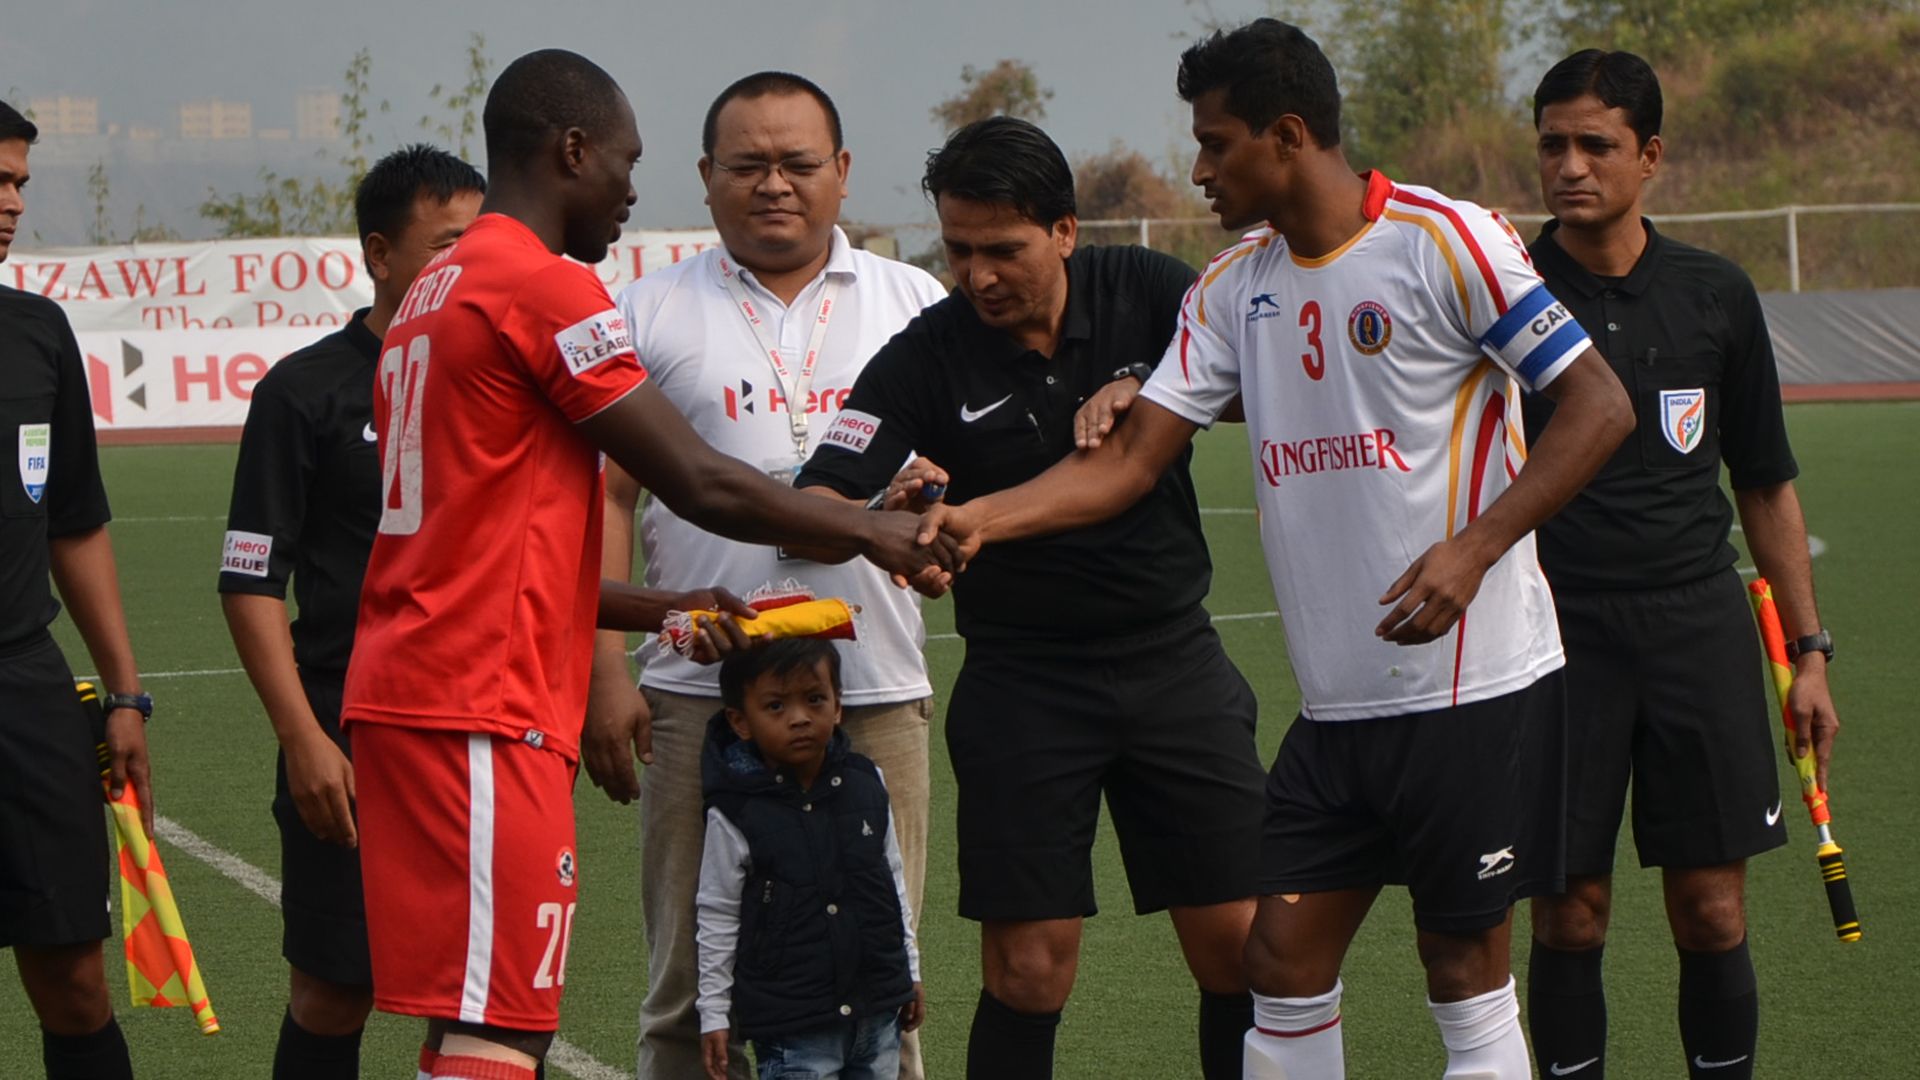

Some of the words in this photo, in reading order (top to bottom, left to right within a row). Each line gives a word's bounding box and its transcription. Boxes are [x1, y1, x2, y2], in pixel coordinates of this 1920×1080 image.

[229, 249, 367, 294] FOO
[588, 243, 720, 284] CL
[254, 301, 352, 328] Peo
[388, 265, 463, 330] LFRED
[607, 318, 625, 332] He
[1299, 300, 1325, 382] 3
[573, 335, 631, 368] I-LEAGU
[172, 352, 270, 402] He
[381, 334, 430, 535] 20
[838, 417, 875, 436] Hero
[28, 457, 45, 470] FIFA
[1260, 428, 1412, 487] KINGFISHER
[234, 541, 268, 556] Hero
